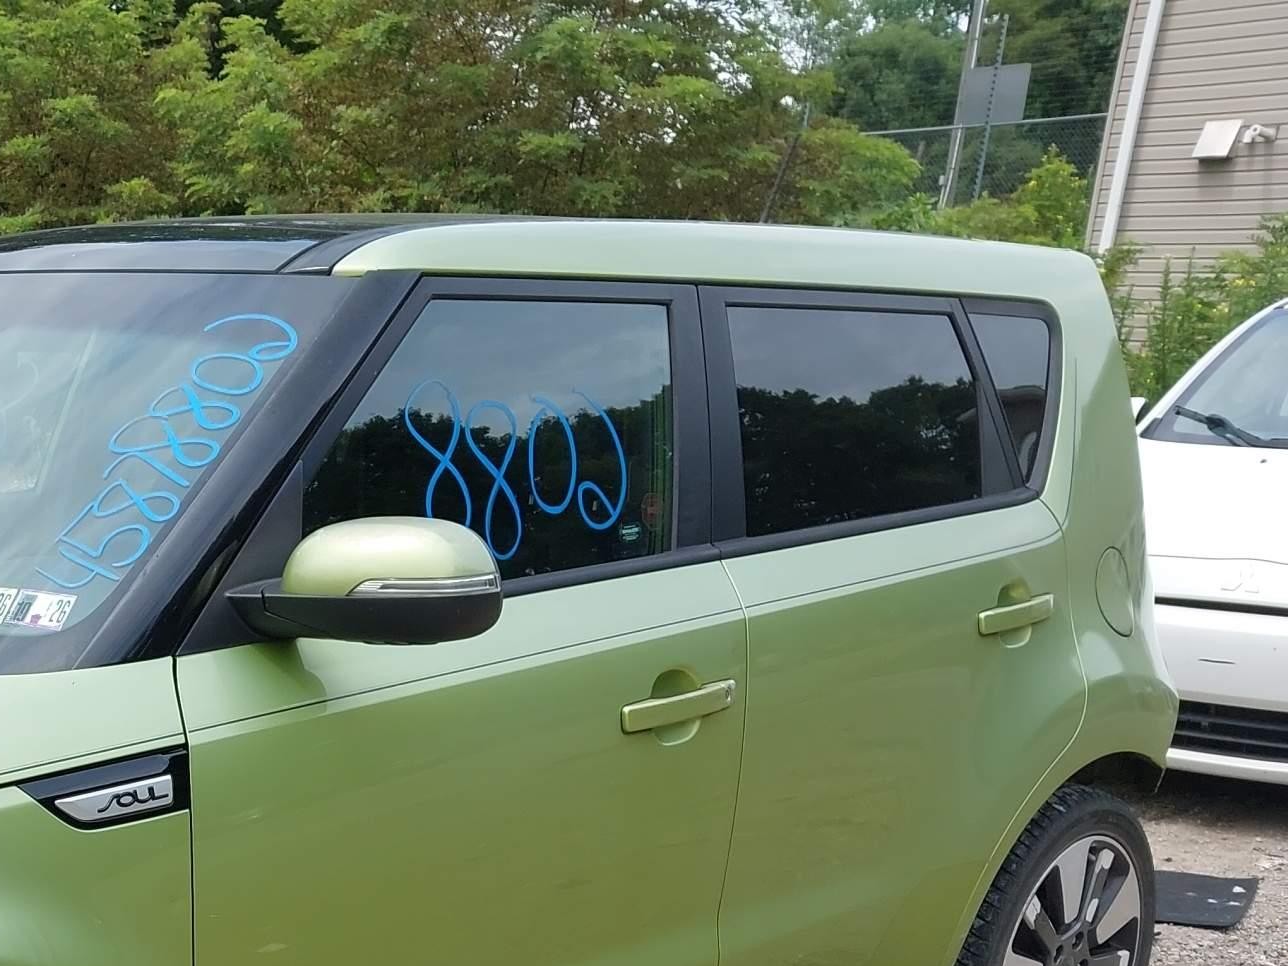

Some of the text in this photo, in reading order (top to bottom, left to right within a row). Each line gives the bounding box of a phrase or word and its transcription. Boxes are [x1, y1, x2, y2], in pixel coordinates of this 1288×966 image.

[35, 312, 299, 589] 45878802
[404, 378, 627, 560] 8802
[48, 599, 71, 623] 26
[97, 786, 169, 814] SOUL
